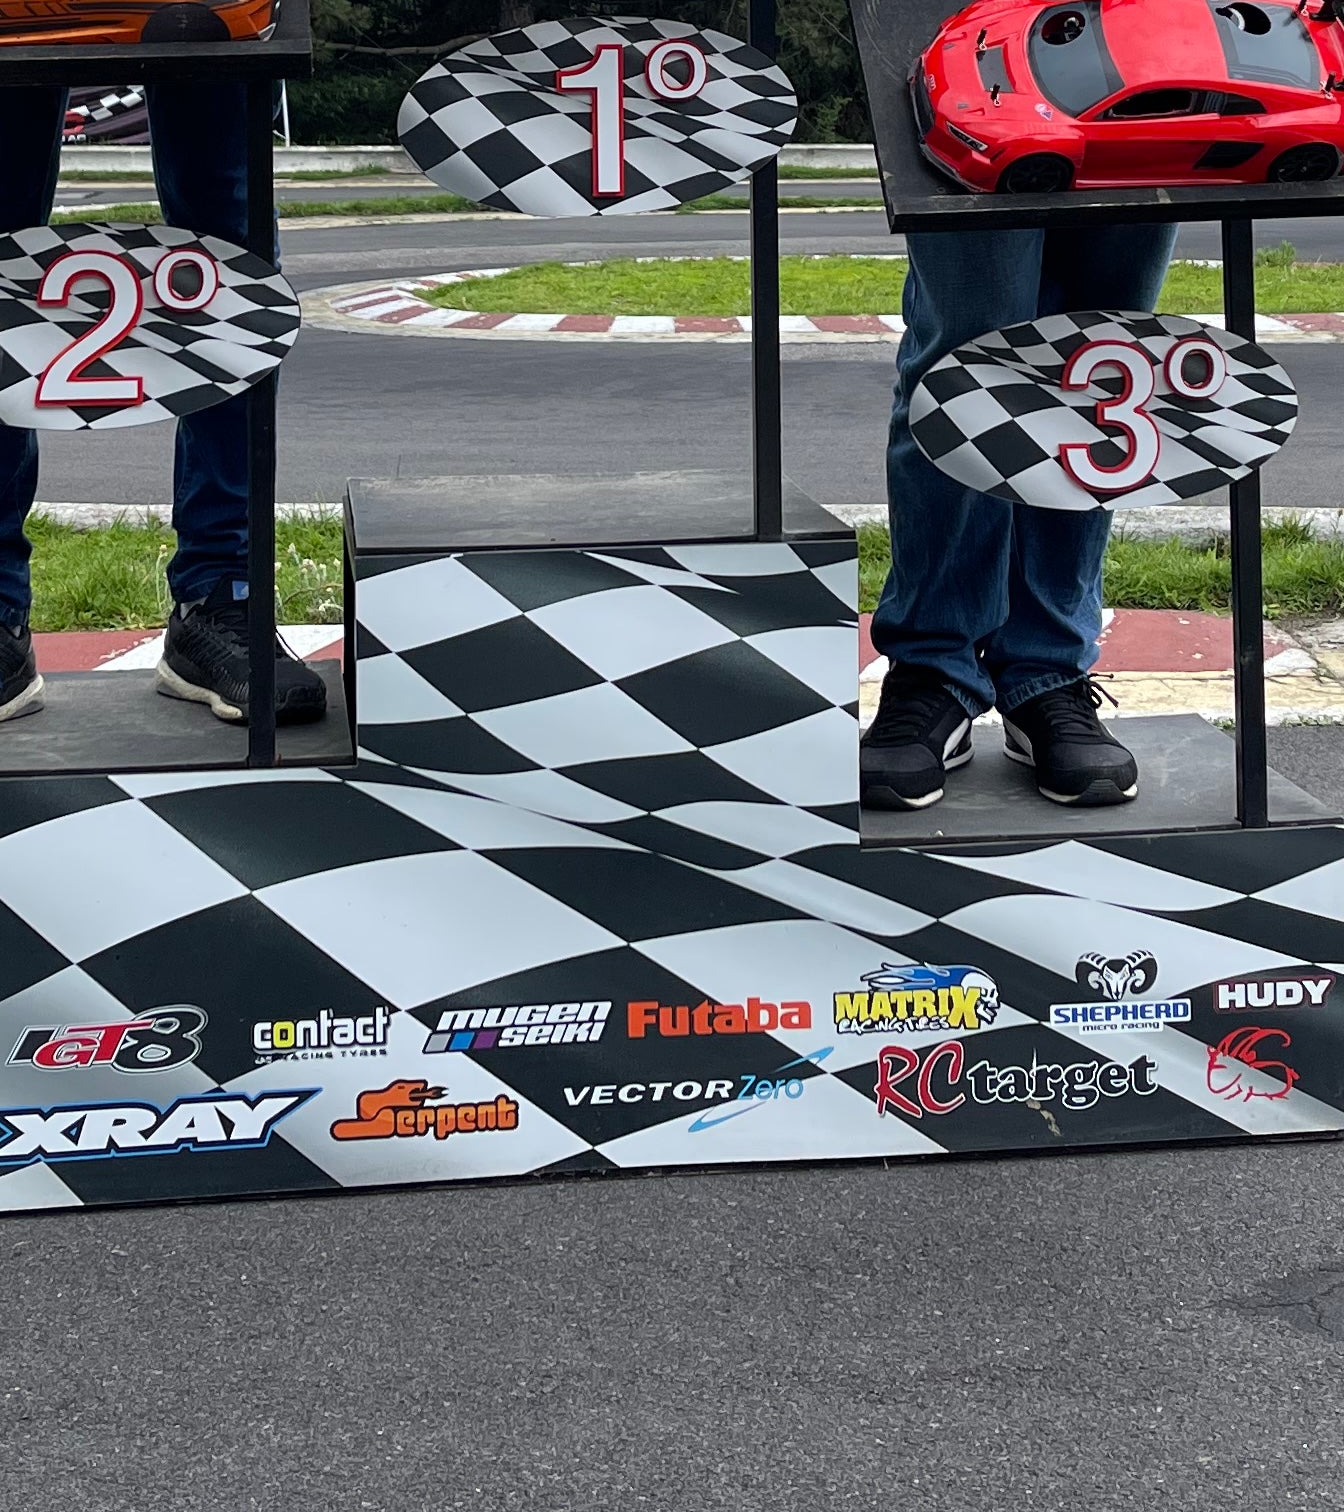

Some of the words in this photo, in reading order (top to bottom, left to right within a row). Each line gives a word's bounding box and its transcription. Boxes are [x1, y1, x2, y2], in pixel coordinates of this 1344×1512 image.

[834, 985, 981, 1029] MATRIX
[1218, 979, 1332, 1009] HUDY
[253, 1005, 389, 1050] contact
[626, 996, 812, 1039] Futaba
[837, 1015, 905, 1035] RACING
[905, 1014, 950, 1032] TIRES
[1054, 1001, 1190, 1024] SHEPHERD
[1081, 1023, 1119, 1033] micro
[1120, 1021, 1161, 1033] racing
[563, 1079, 734, 1106] VECTOR
[737, 1074, 805, 1101] Zero
[331, 1079, 519, 1140] Serpent
